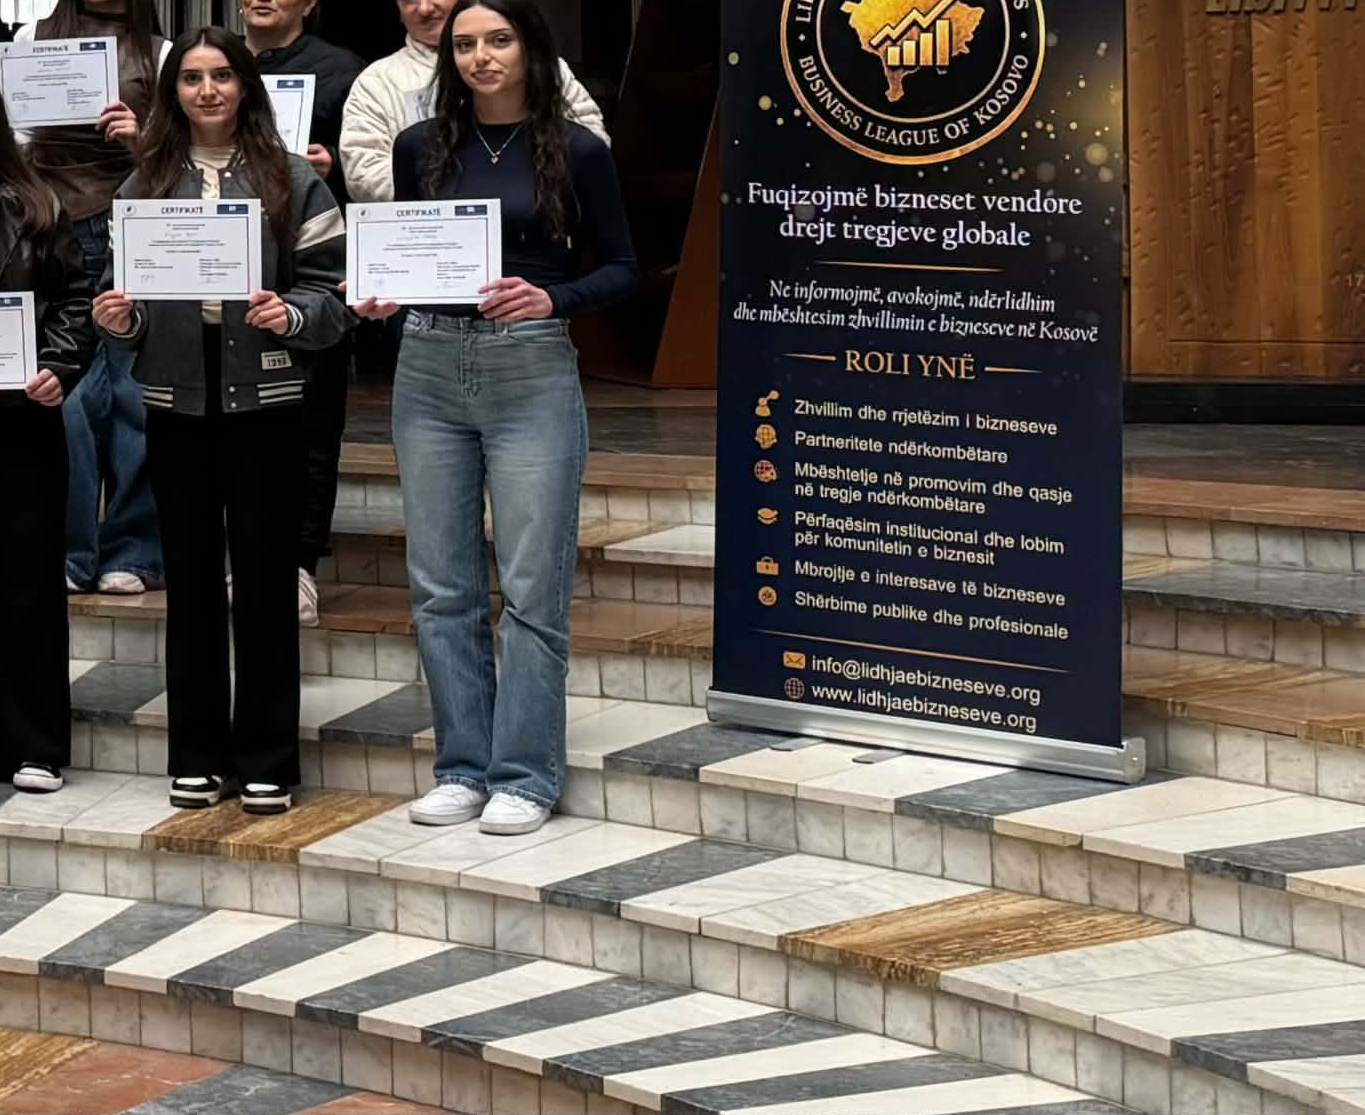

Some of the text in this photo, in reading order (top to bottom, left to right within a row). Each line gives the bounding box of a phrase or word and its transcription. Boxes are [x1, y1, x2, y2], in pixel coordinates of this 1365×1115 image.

[798, 53, 1030, 146] BUSINESS LEAGUE OF KOSOVO
[747, 182, 1083, 215] Fuqizojmë bizneset vendore
[779, 214, 1032, 251] drejt tregjeve globale
[769, 279, 1056, 313] Ne informojmë, avokojmë, ndërlidhim
[733, 302, 757, 320] dhe
[848, 309, 926, 332] zhvillimin
[939, 315, 1016, 338] bizneseve
[1039, 320, 1100, 343] Kosovë
[844, 349, 976, 380] ROLI YNË
[794, 399, 853, 418] Zhvillim
[857, 405, 887, 421] dhe
[892, 408, 960, 427] rrjetëzim
[976, 414, 1058, 435] bizneseve
[794, 430, 1008, 464] Partneritete ndërkombëtare
[795, 483, 986, 514] në tregje ndërkombëtare
[884, 471, 903, 486] në
[908, 474, 986, 495] promovim
[992, 481, 1024, 498] dhe
[1028, 486, 1073, 506] qasje
[794, 510, 1065, 555] Përfaqësim institucional dhe lobim
[794, 531, 996, 566] për komunitetin e biznesit
[794, 559, 1066, 606] Mbrojtje e interesave të bizneseve
[794, 590, 1070, 640] Shërbime publike dhe profesionale
[811, 655, 1041, 707] info@lidhjaebizneseve.org
[811, 685, 1038, 734] www.lidhjaebizneseve.org
